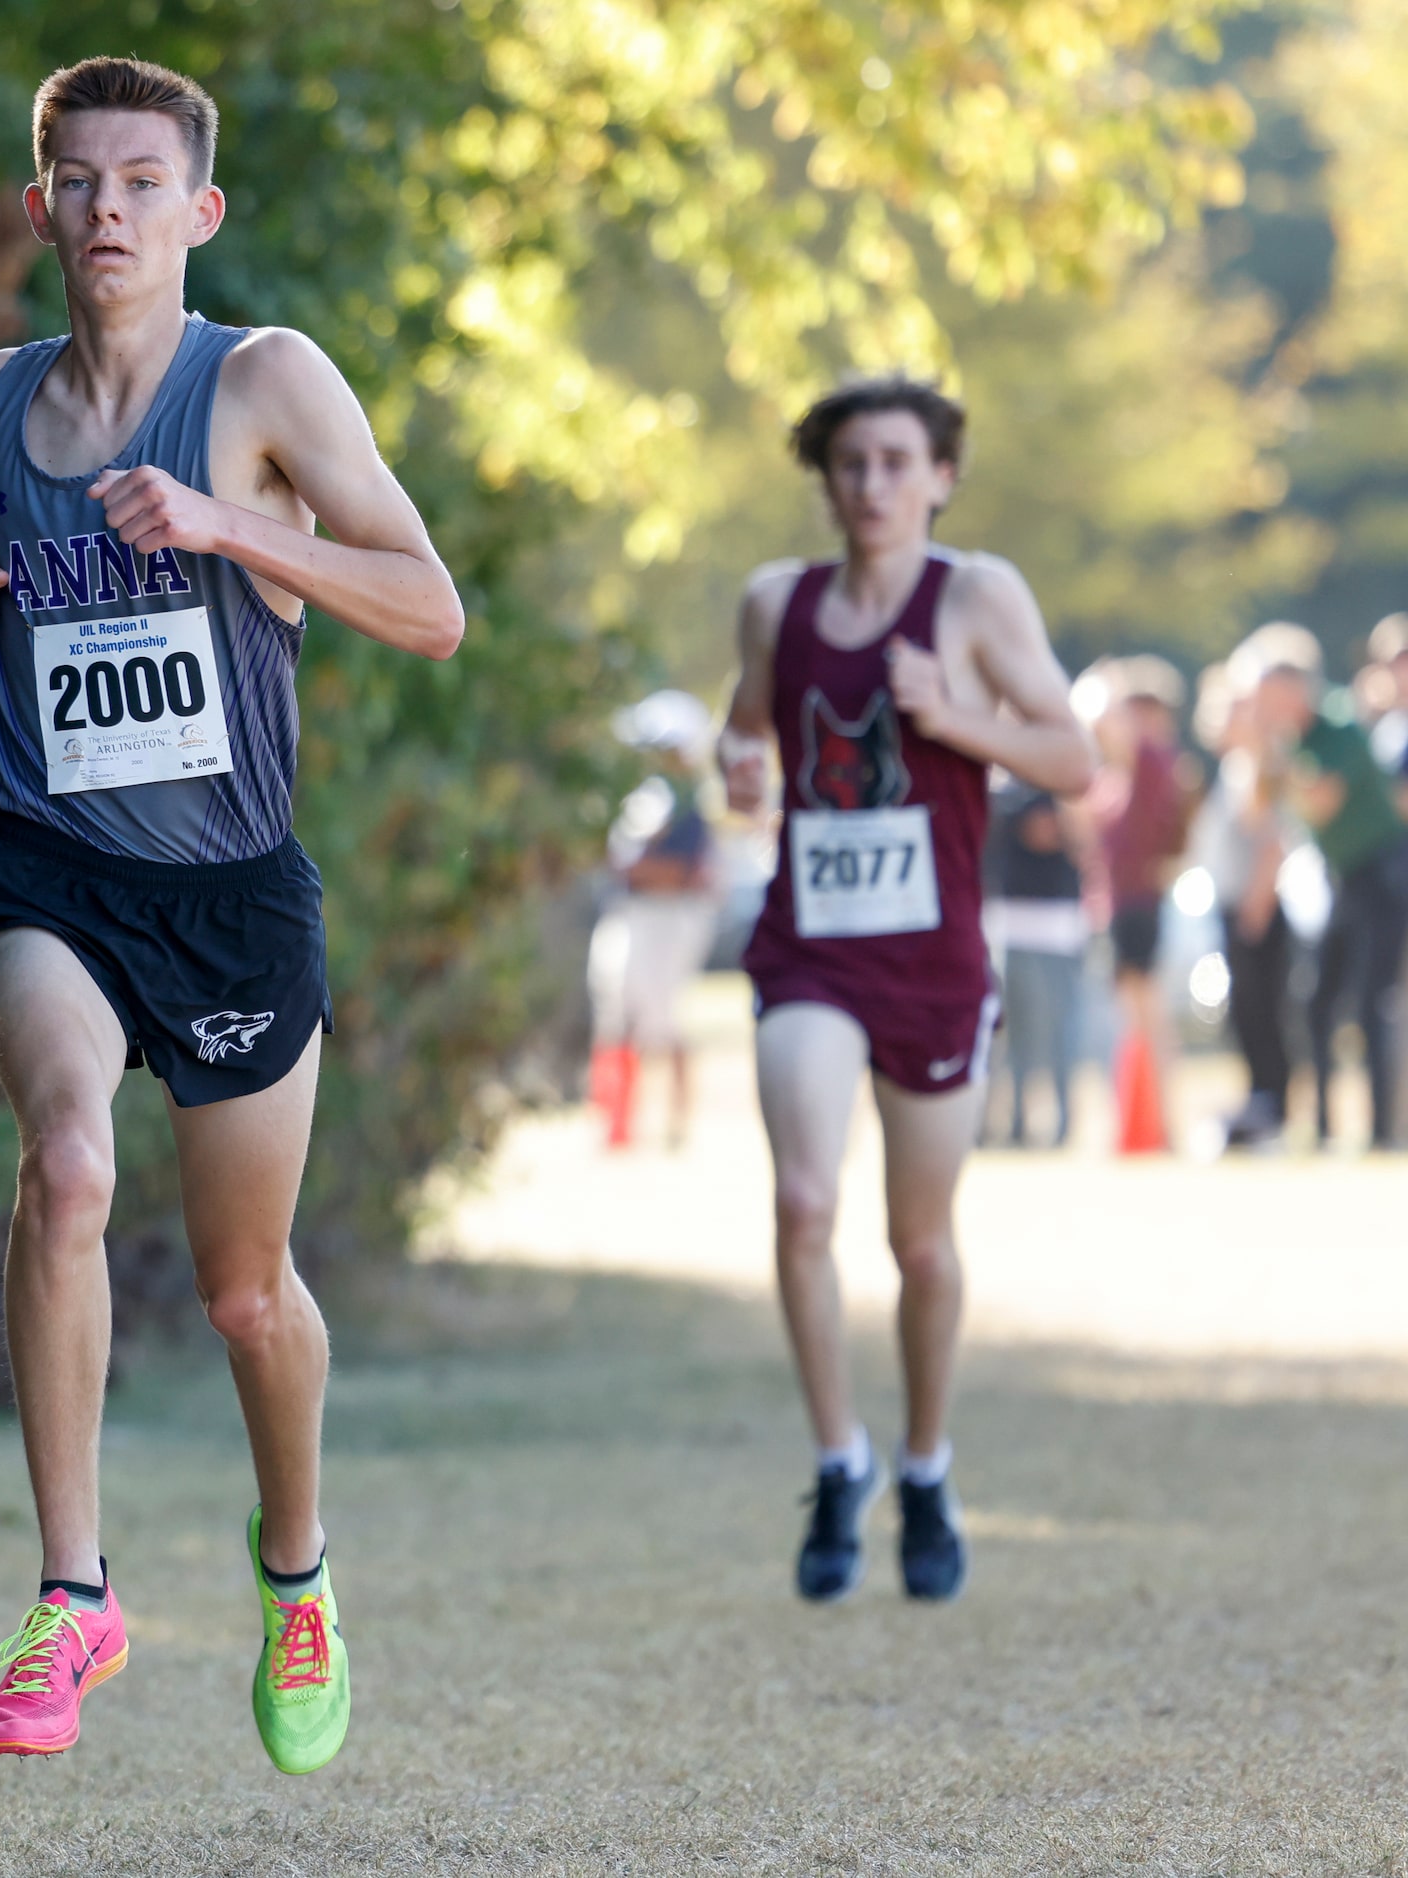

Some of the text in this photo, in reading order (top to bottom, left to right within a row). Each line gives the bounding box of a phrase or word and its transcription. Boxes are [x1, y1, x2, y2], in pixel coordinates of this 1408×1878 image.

[9, 531, 192, 611] ANNA
[79, 618, 148, 637] UIL Region II
[69, 635, 167, 656] XC Championship
[49, 651, 206, 731] 2000
[102, 732, 138, 743] University
[140, 730, 149, 738] of
[150, 728, 171, 736] Texas
[96, 738, 166, 755] ARLINGTON
[182, 756, 218, 770] No. 2000
[806, 844, 916, 889] 2077
